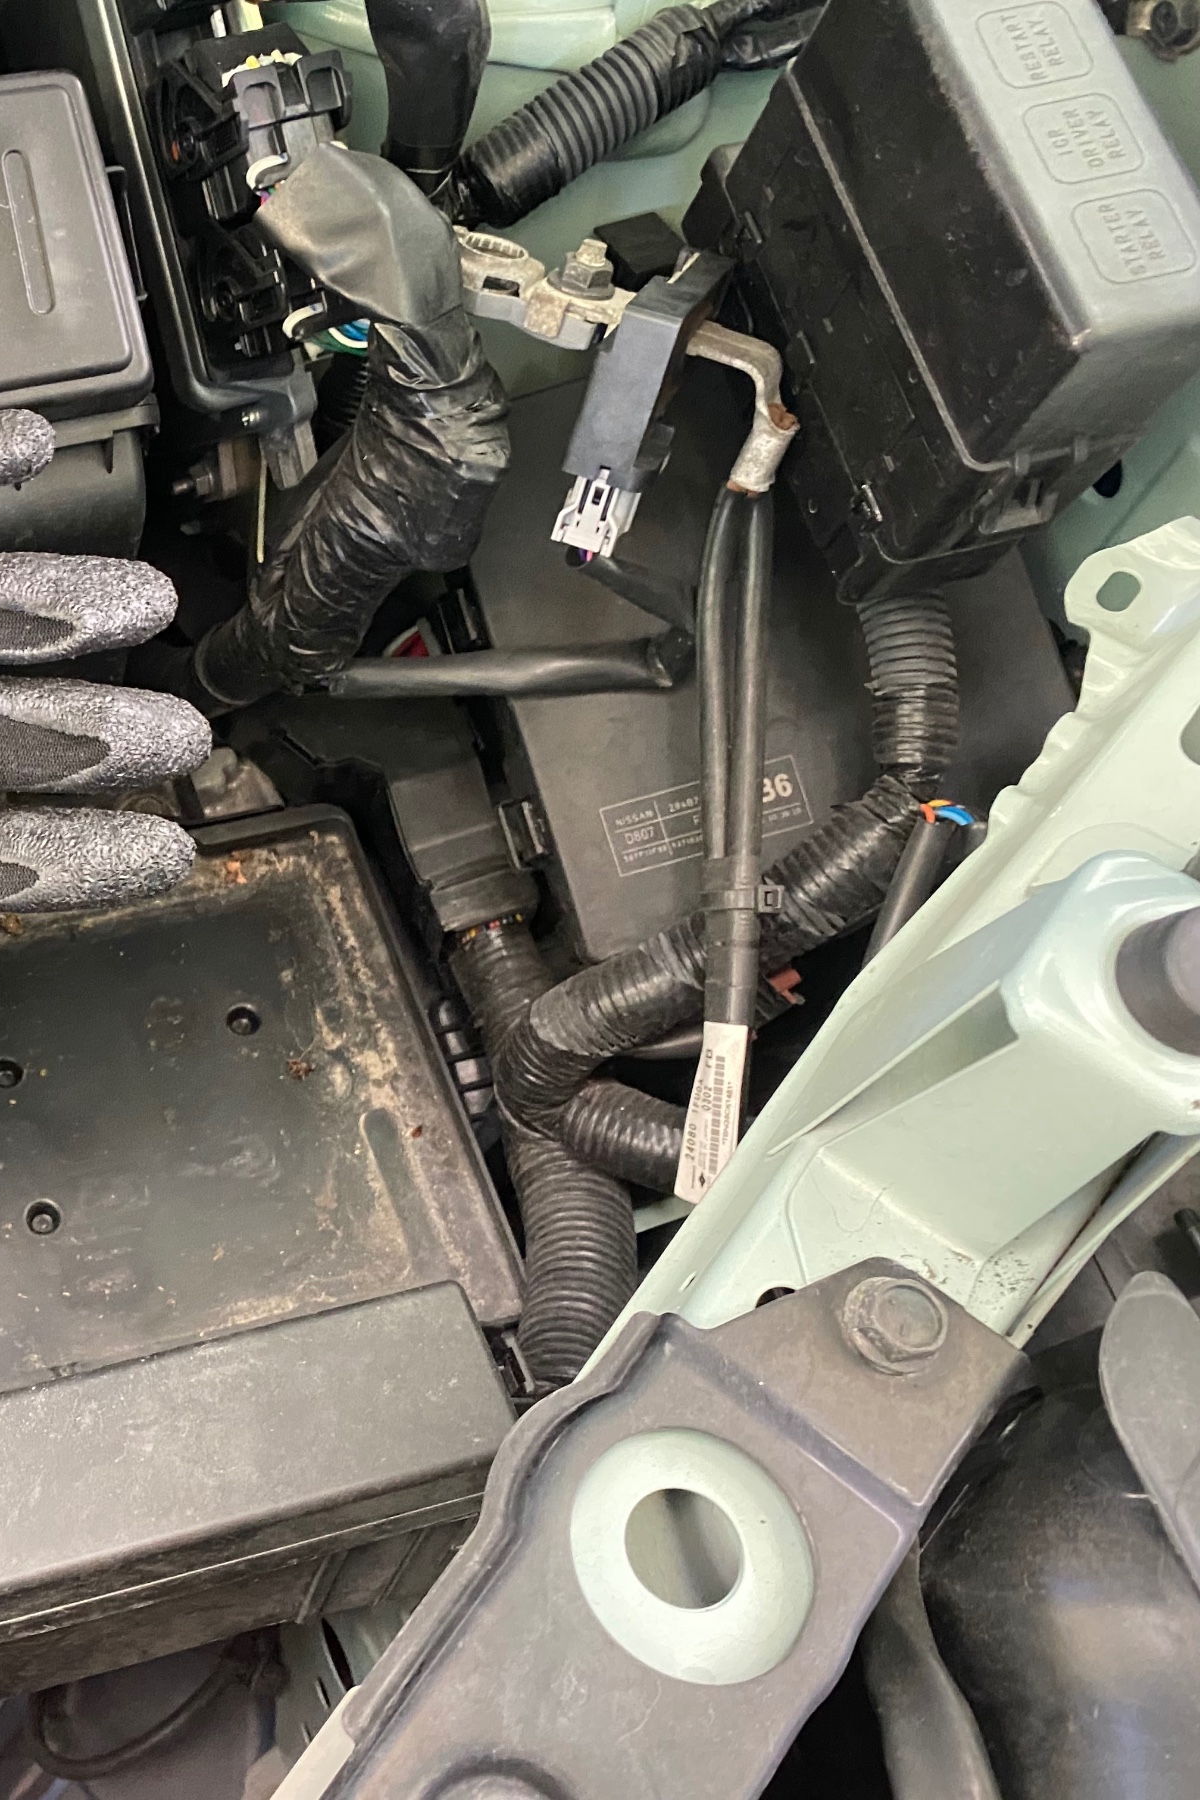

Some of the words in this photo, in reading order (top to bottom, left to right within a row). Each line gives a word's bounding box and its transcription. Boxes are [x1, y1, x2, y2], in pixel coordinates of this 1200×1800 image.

[1000, 14, 1049, 81] RESTART
[1027, 18, 1065, 67] RELAY
[1046, 128, 1073, 157] IGR
[1062, 107, 1105, 169] DRIVER
[1085, 109, 1127, 160] RELAY
[1096, 202, 1147, 276] STARTER
[1124, 209, 1167, 261] RELAY
[684, 1122, 698, 1161] 24080
